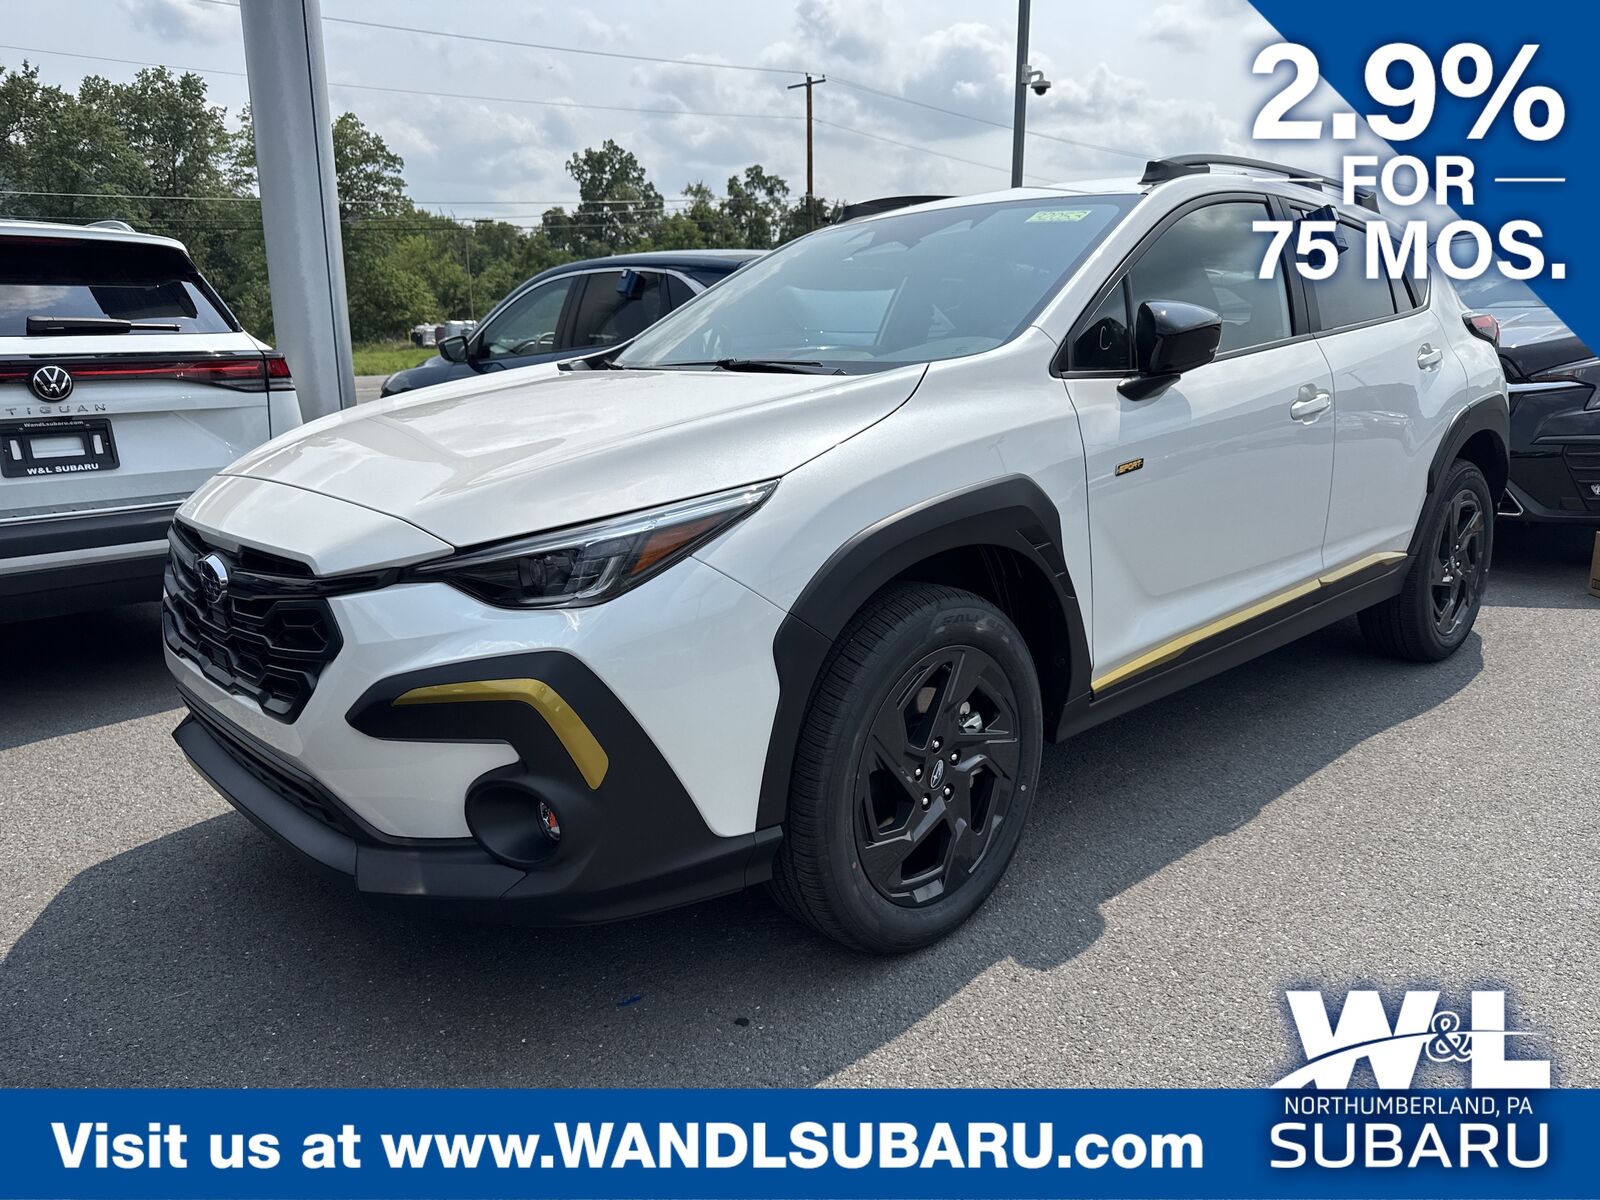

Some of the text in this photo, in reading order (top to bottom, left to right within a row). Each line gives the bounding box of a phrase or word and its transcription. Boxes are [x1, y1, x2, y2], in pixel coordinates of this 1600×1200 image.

[5, 403, 107, 415] TIGUAN
[27, 463, 99, 475] W&L SUBARU
